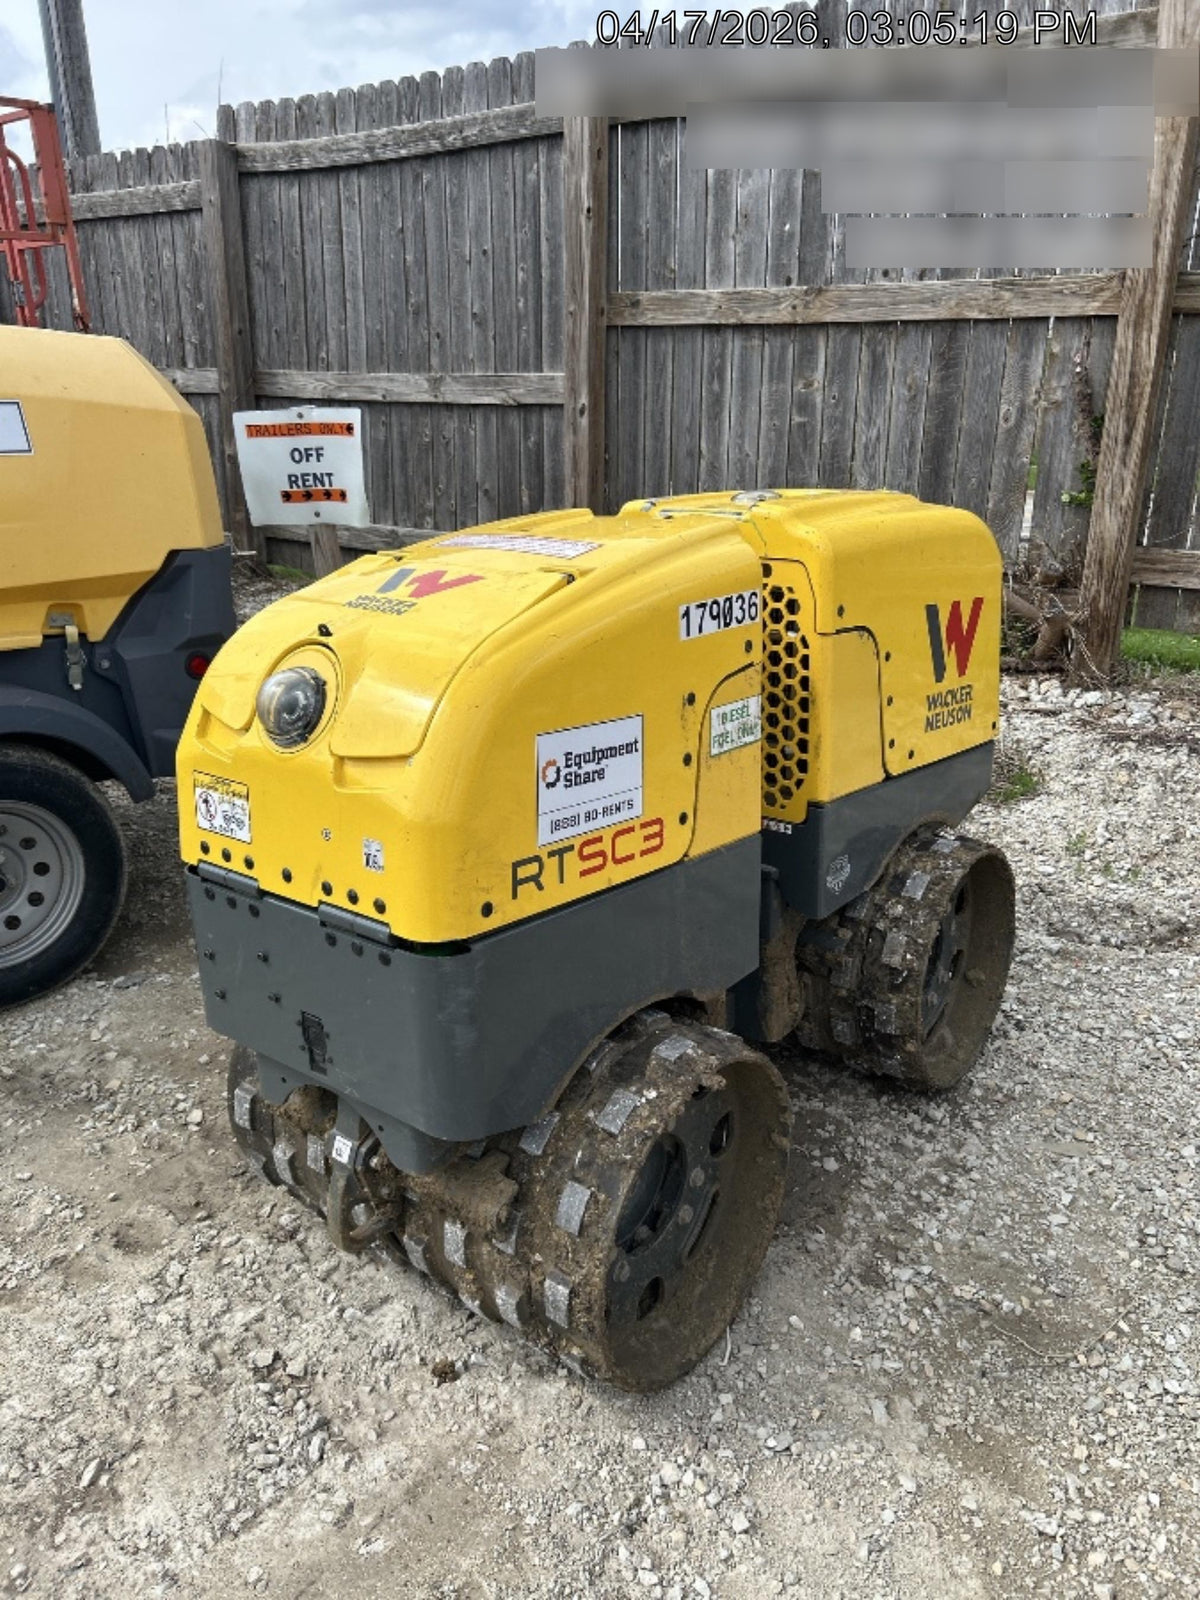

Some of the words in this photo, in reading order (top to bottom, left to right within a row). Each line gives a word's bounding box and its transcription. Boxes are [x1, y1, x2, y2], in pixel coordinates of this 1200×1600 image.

[246, 422, 312, 437] TRAILERS
[319, 422, 346, 435] ONLY
[290, 446, 324, 464] OFF
[287, 472, 334, 489] RENT
[681, 591, 759, 638] 179036
[925, 684, 974, 712] WACKER
[924, 704, 973, 733] NEUSON
[563, 737, 640, 770] Equipment
[563, 767, 606, 790] Share
[584, 798, 635, 824] 80-RENTS
[511, 816, 665, 901] RTSC3
